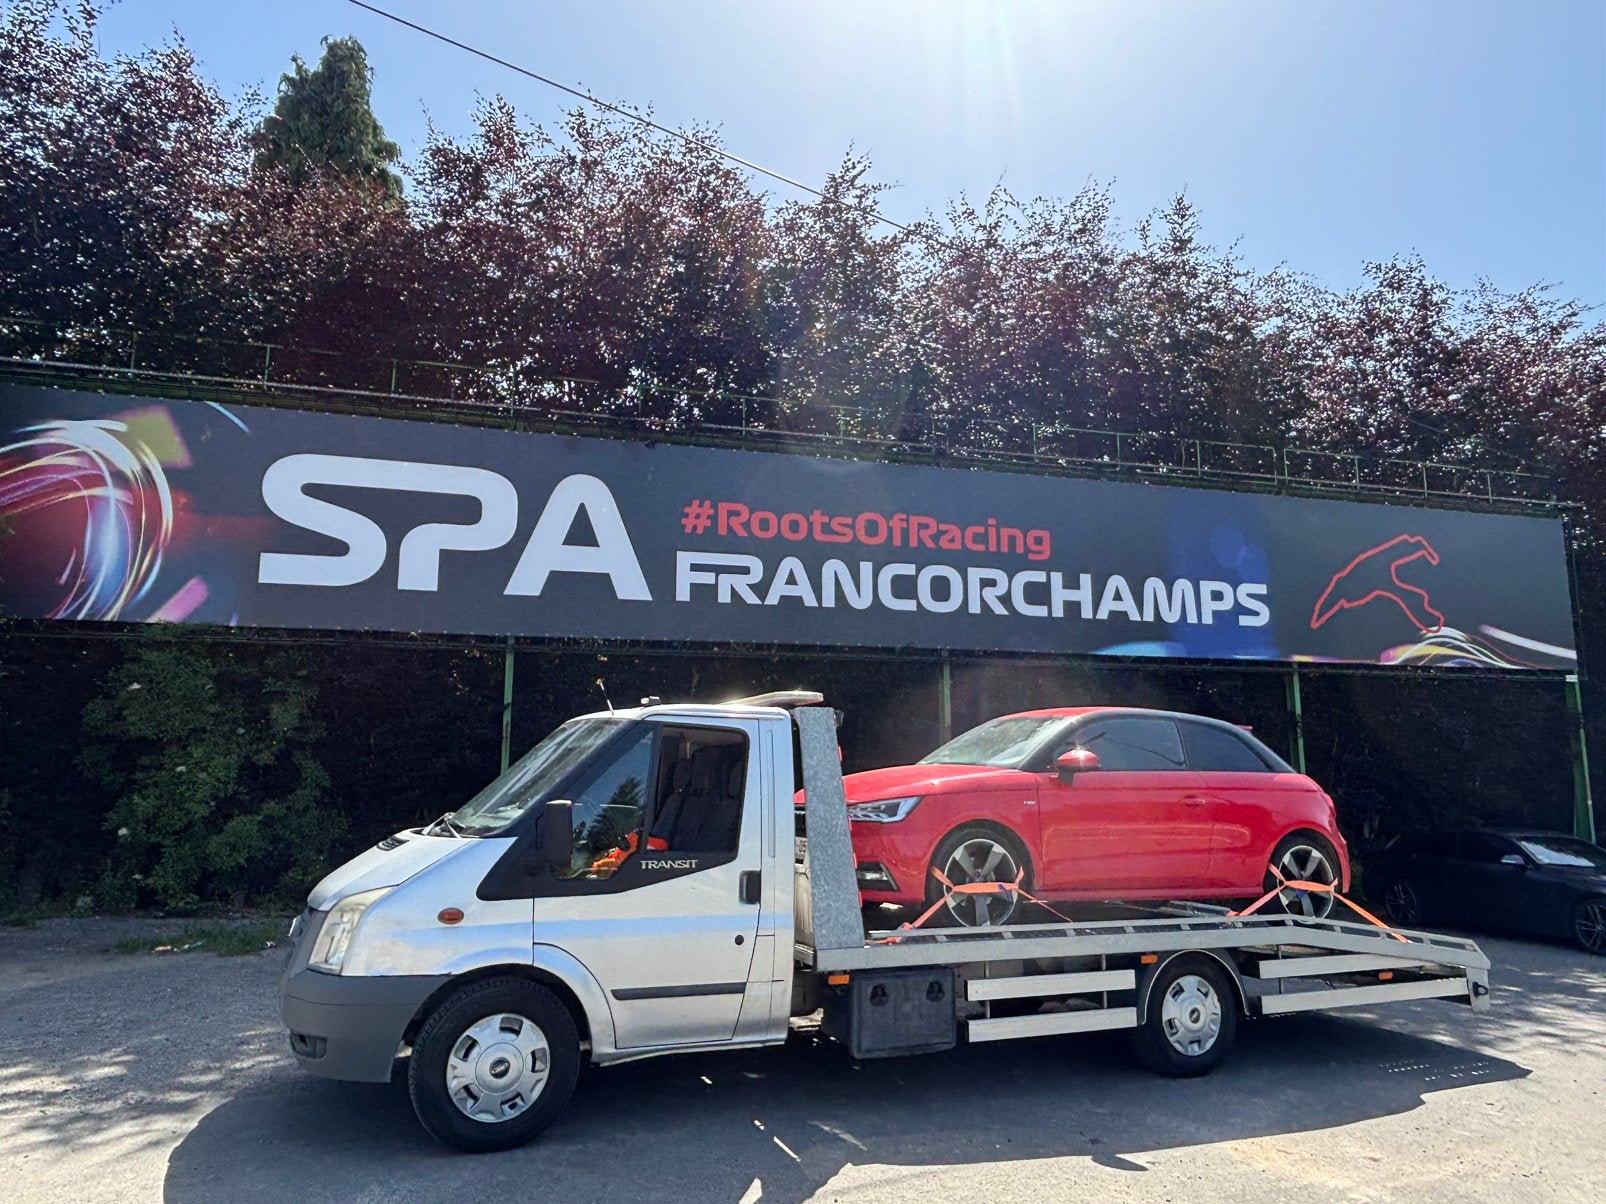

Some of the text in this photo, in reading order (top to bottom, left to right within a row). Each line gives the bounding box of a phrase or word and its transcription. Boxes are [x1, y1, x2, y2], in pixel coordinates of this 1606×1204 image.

[258, 453, 653, 601] SPA
[681, 499, 1051, 561] #RootsOfRacing
[675, 550, 1270, 627] FRANCORCHAMPS
[640, 859, 698, 870] TRANSIT
